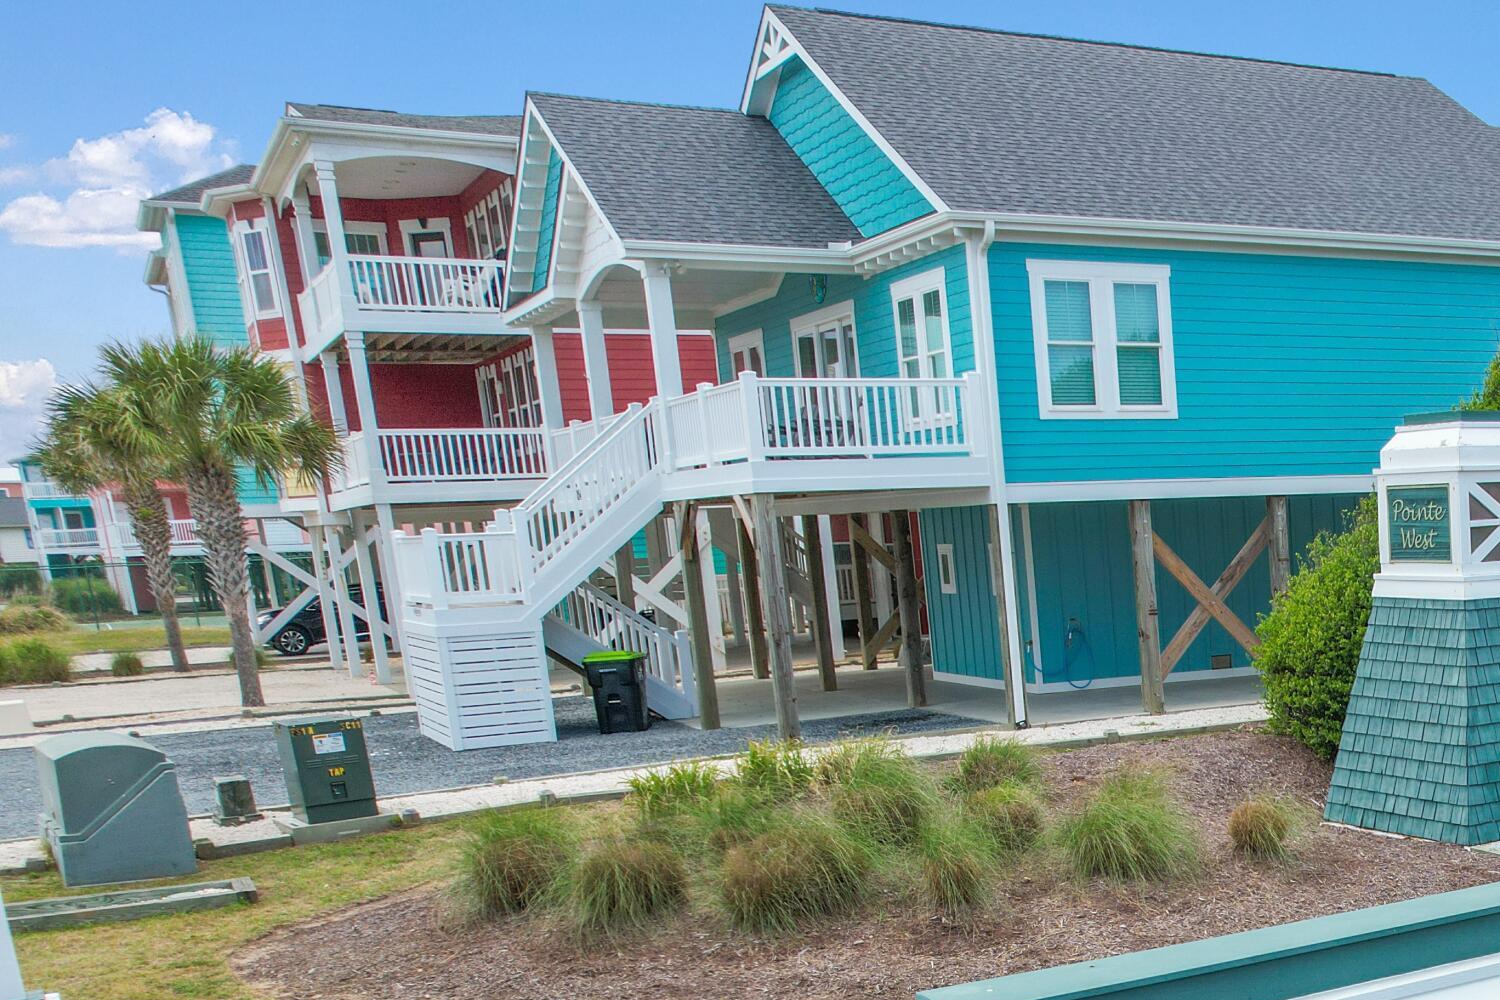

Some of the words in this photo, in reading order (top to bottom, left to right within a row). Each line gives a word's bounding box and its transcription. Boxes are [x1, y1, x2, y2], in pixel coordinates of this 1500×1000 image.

[1392, 499, 1446, 521] Pointe
[1401, 527, 1438, 550] West
[328, 767, 345, 777] TAP
